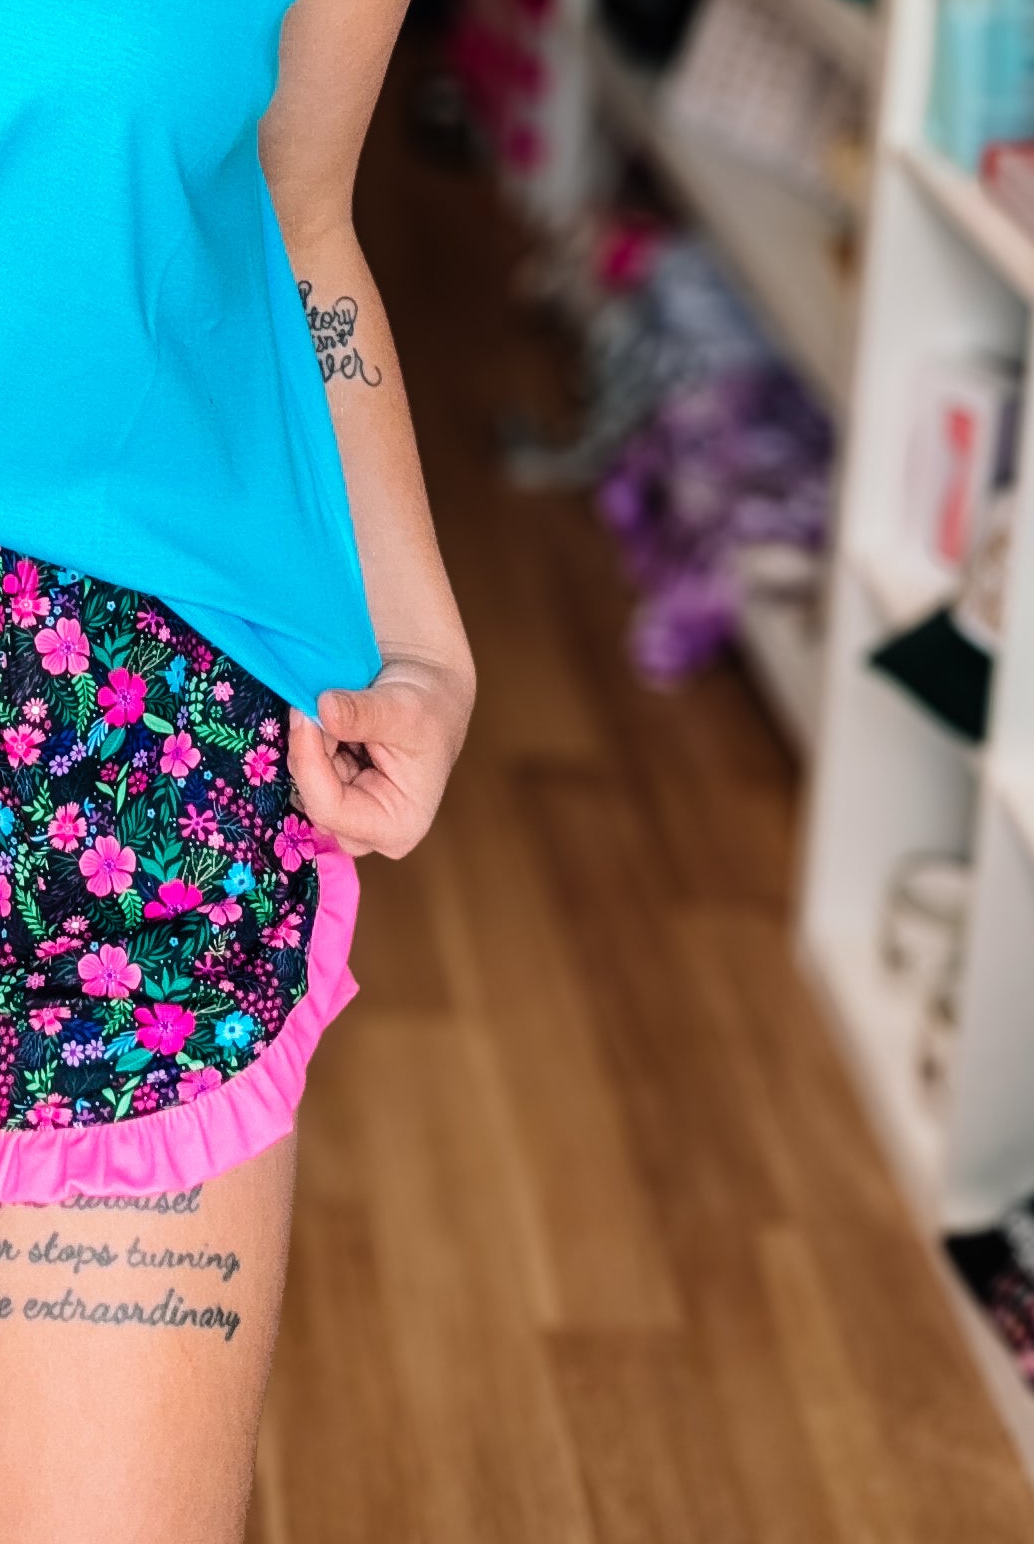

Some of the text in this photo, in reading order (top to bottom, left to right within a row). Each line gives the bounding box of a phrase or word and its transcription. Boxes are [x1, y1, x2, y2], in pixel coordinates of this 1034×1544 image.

[312, 327, 349, 353] sn't
[318, 348, 382, 387] ver
[28, 1230, 118, 1274] stops
[127, 1236, 241, 1282] turning
[23, 1287, 241, 1342] extraordinary
